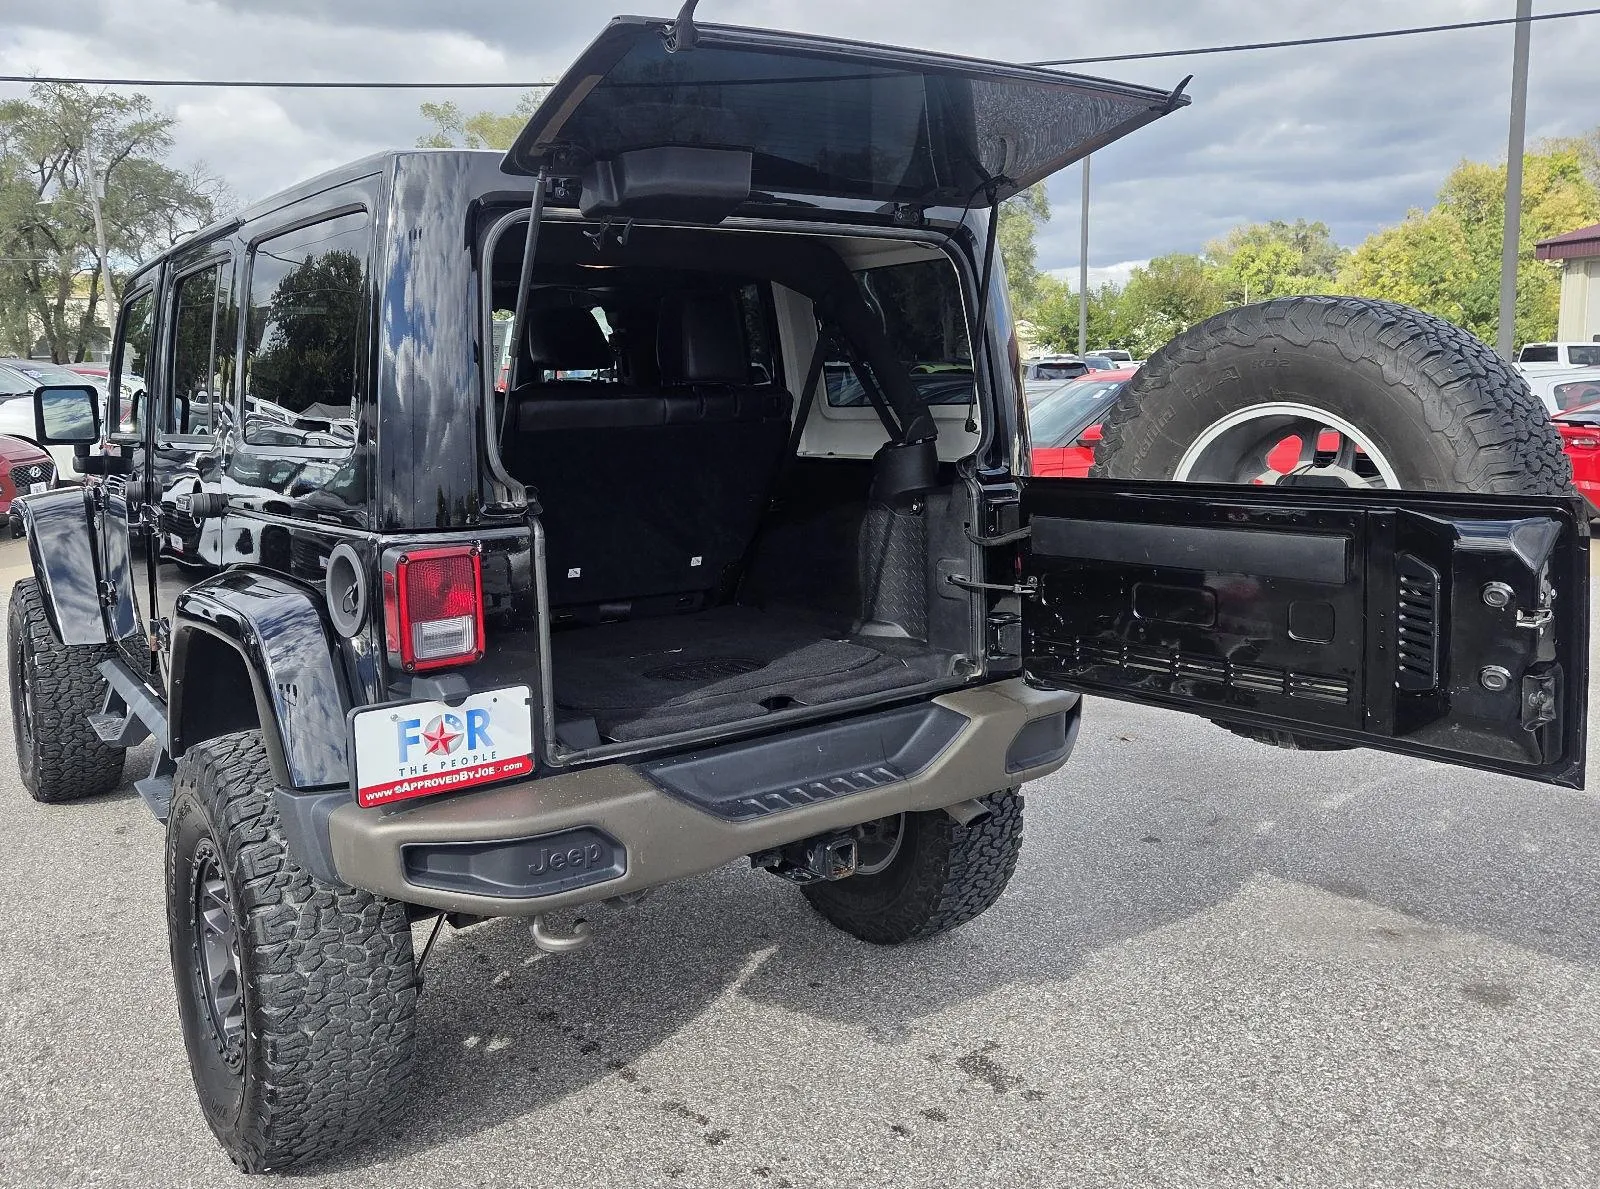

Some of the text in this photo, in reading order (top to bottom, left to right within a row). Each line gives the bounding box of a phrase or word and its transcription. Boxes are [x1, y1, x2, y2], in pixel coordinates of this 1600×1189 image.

[397, 708, 496, 764] FOR
[398, 750, 497, 778] THE PEOPLE
[528, 841, 602, 876] Jeep
